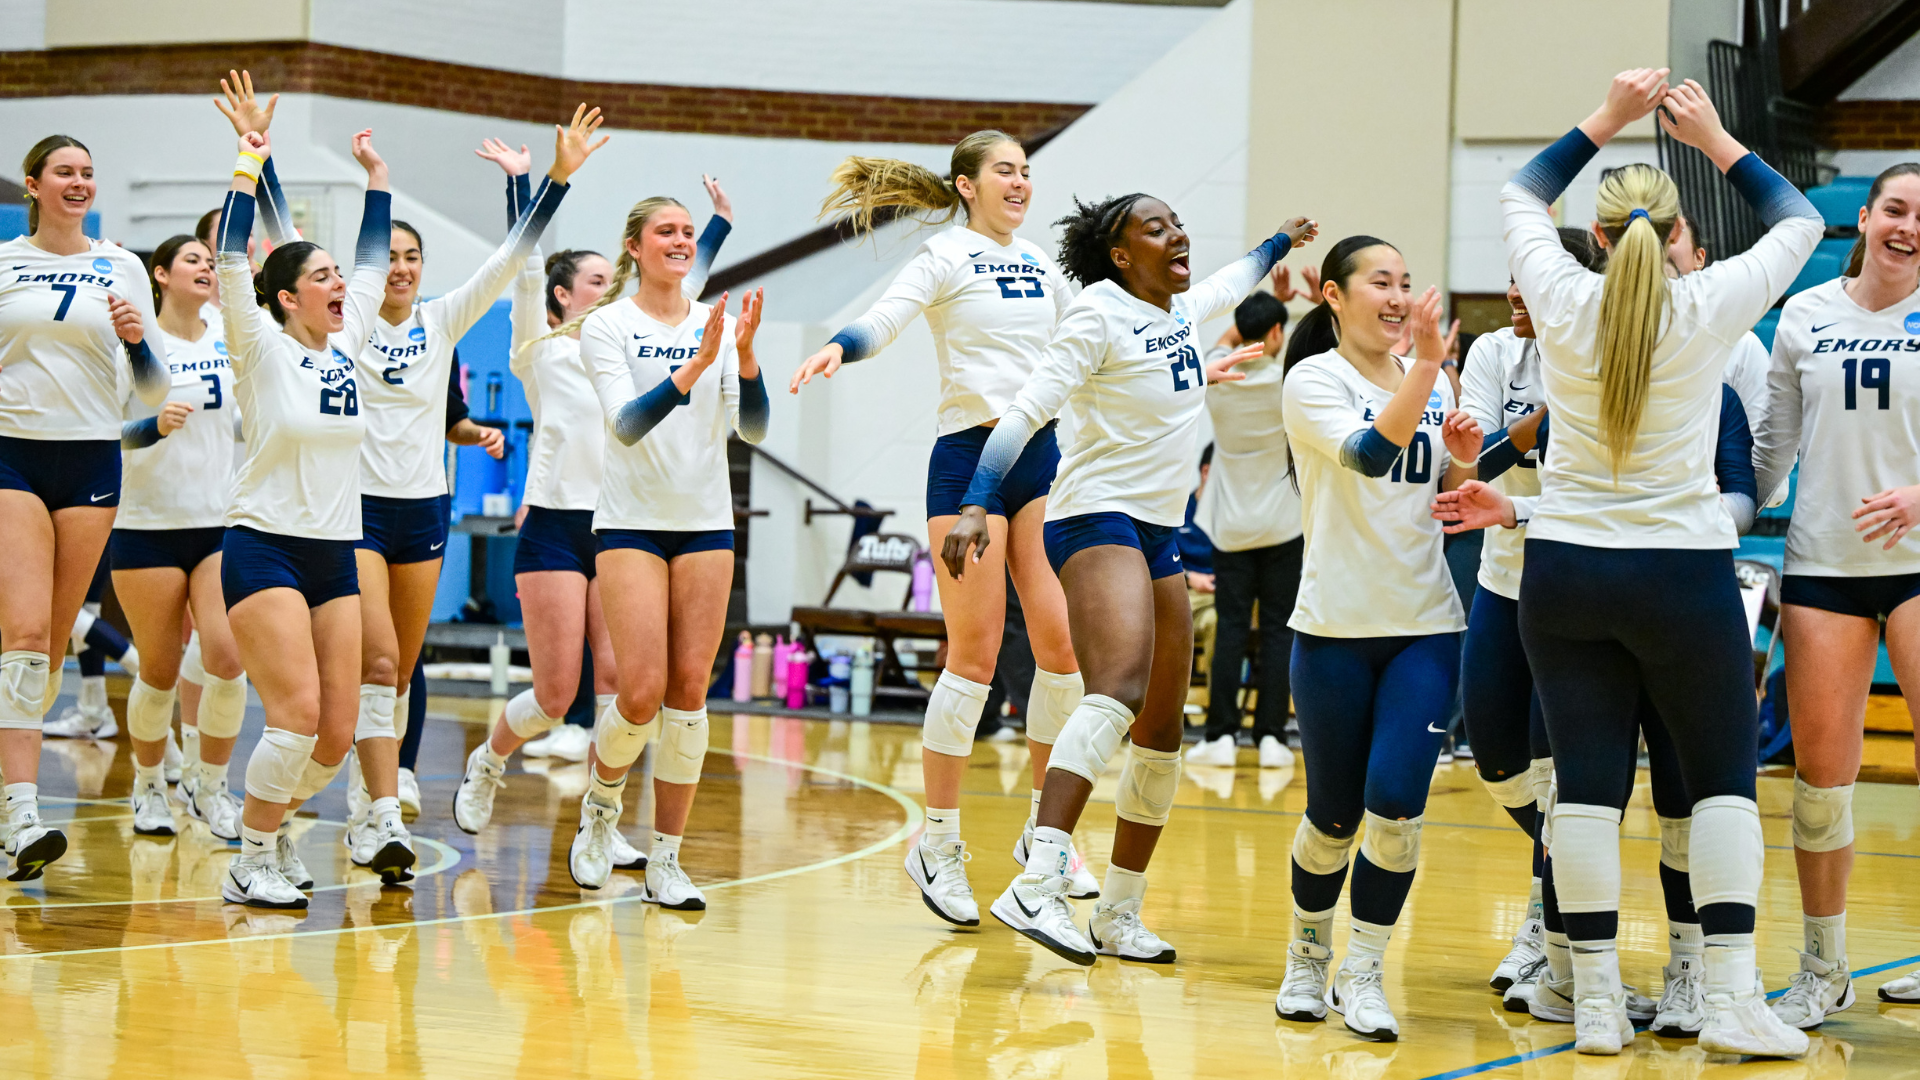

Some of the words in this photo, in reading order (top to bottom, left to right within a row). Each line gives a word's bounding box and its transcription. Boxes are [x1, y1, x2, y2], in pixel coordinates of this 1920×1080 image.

[16, 273, 114, 287] EMORY
[51, 283, 77, 322] 7
[1812, 338, 1920, 354] EMORY
[1166, 344, 1204, 392] 24
[1841, 358, 1891, 410] 19
[199, 373, 223, 411] 3
[319, 376, 359, 416] 28
[1391, 431, 1432, 484] 10
[857, 535, 912, 561] Tufts
